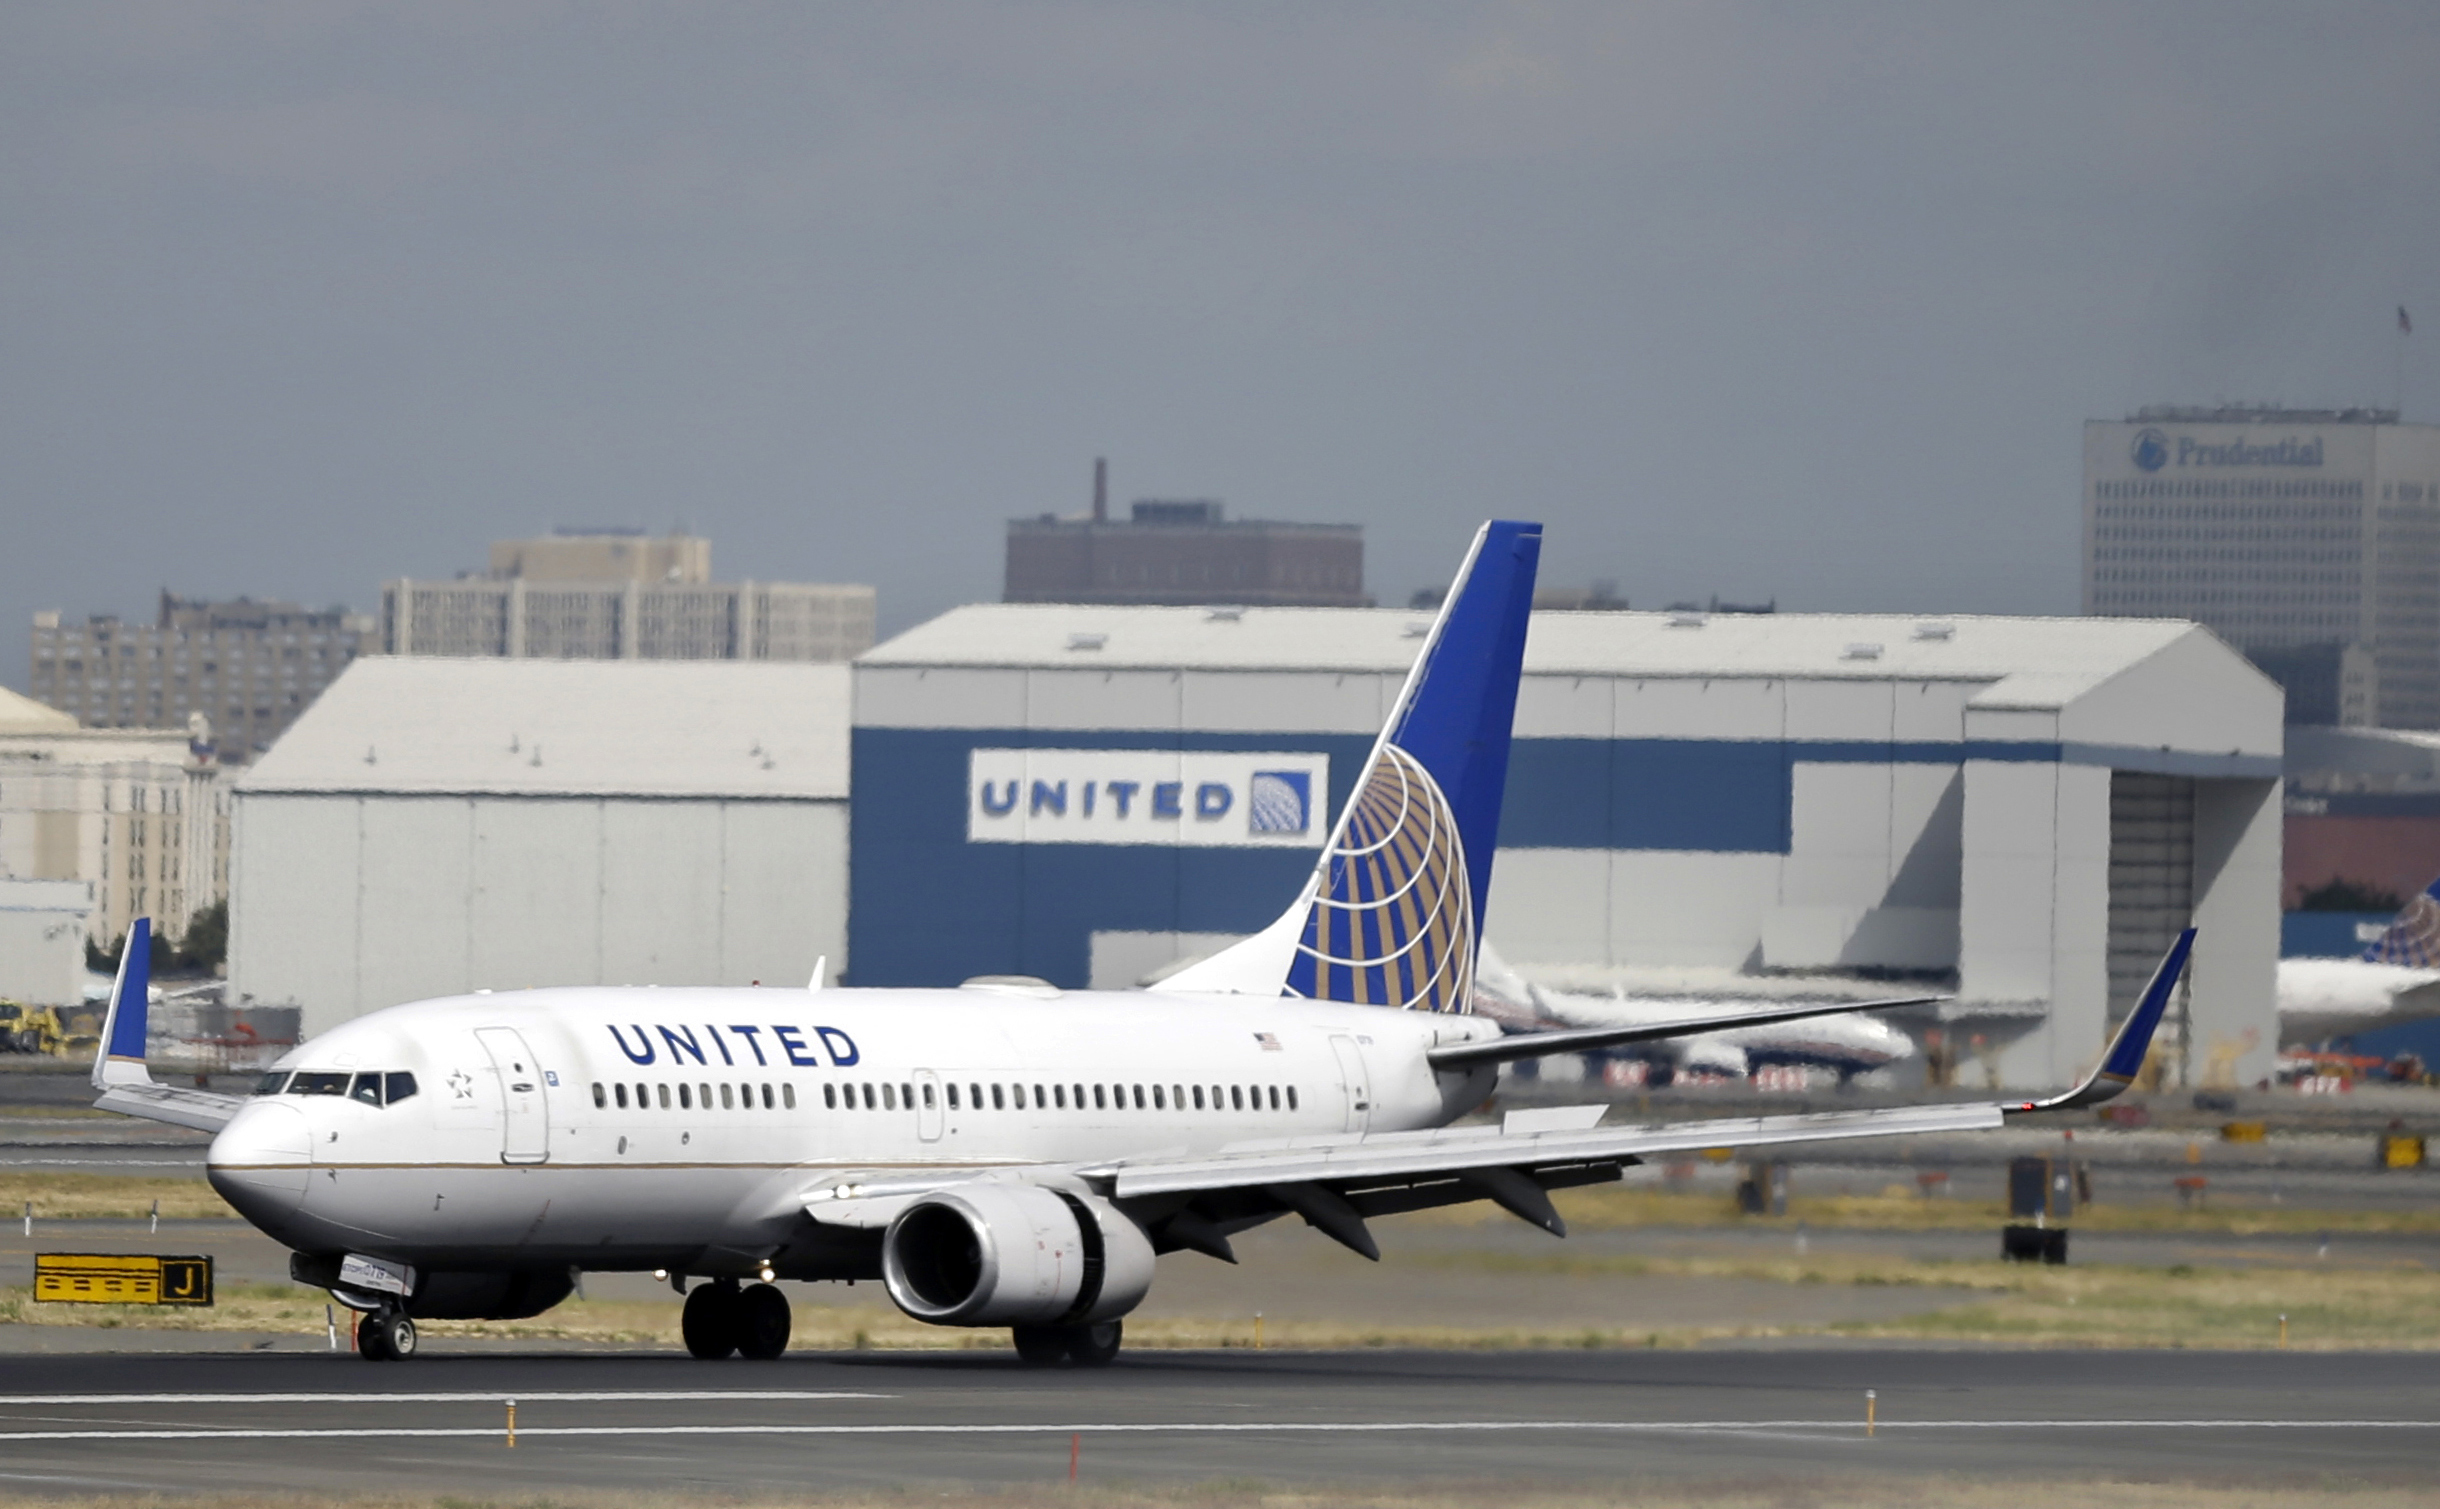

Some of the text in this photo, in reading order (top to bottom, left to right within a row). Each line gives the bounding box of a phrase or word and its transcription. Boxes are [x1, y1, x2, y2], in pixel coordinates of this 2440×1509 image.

[2177, 435, 2323, 466] Prudential
[981, 780, 1234, 820] UNITED
[606, 1024, 860, 1067] UNITED
[174, 1267, 194, 1296] J
